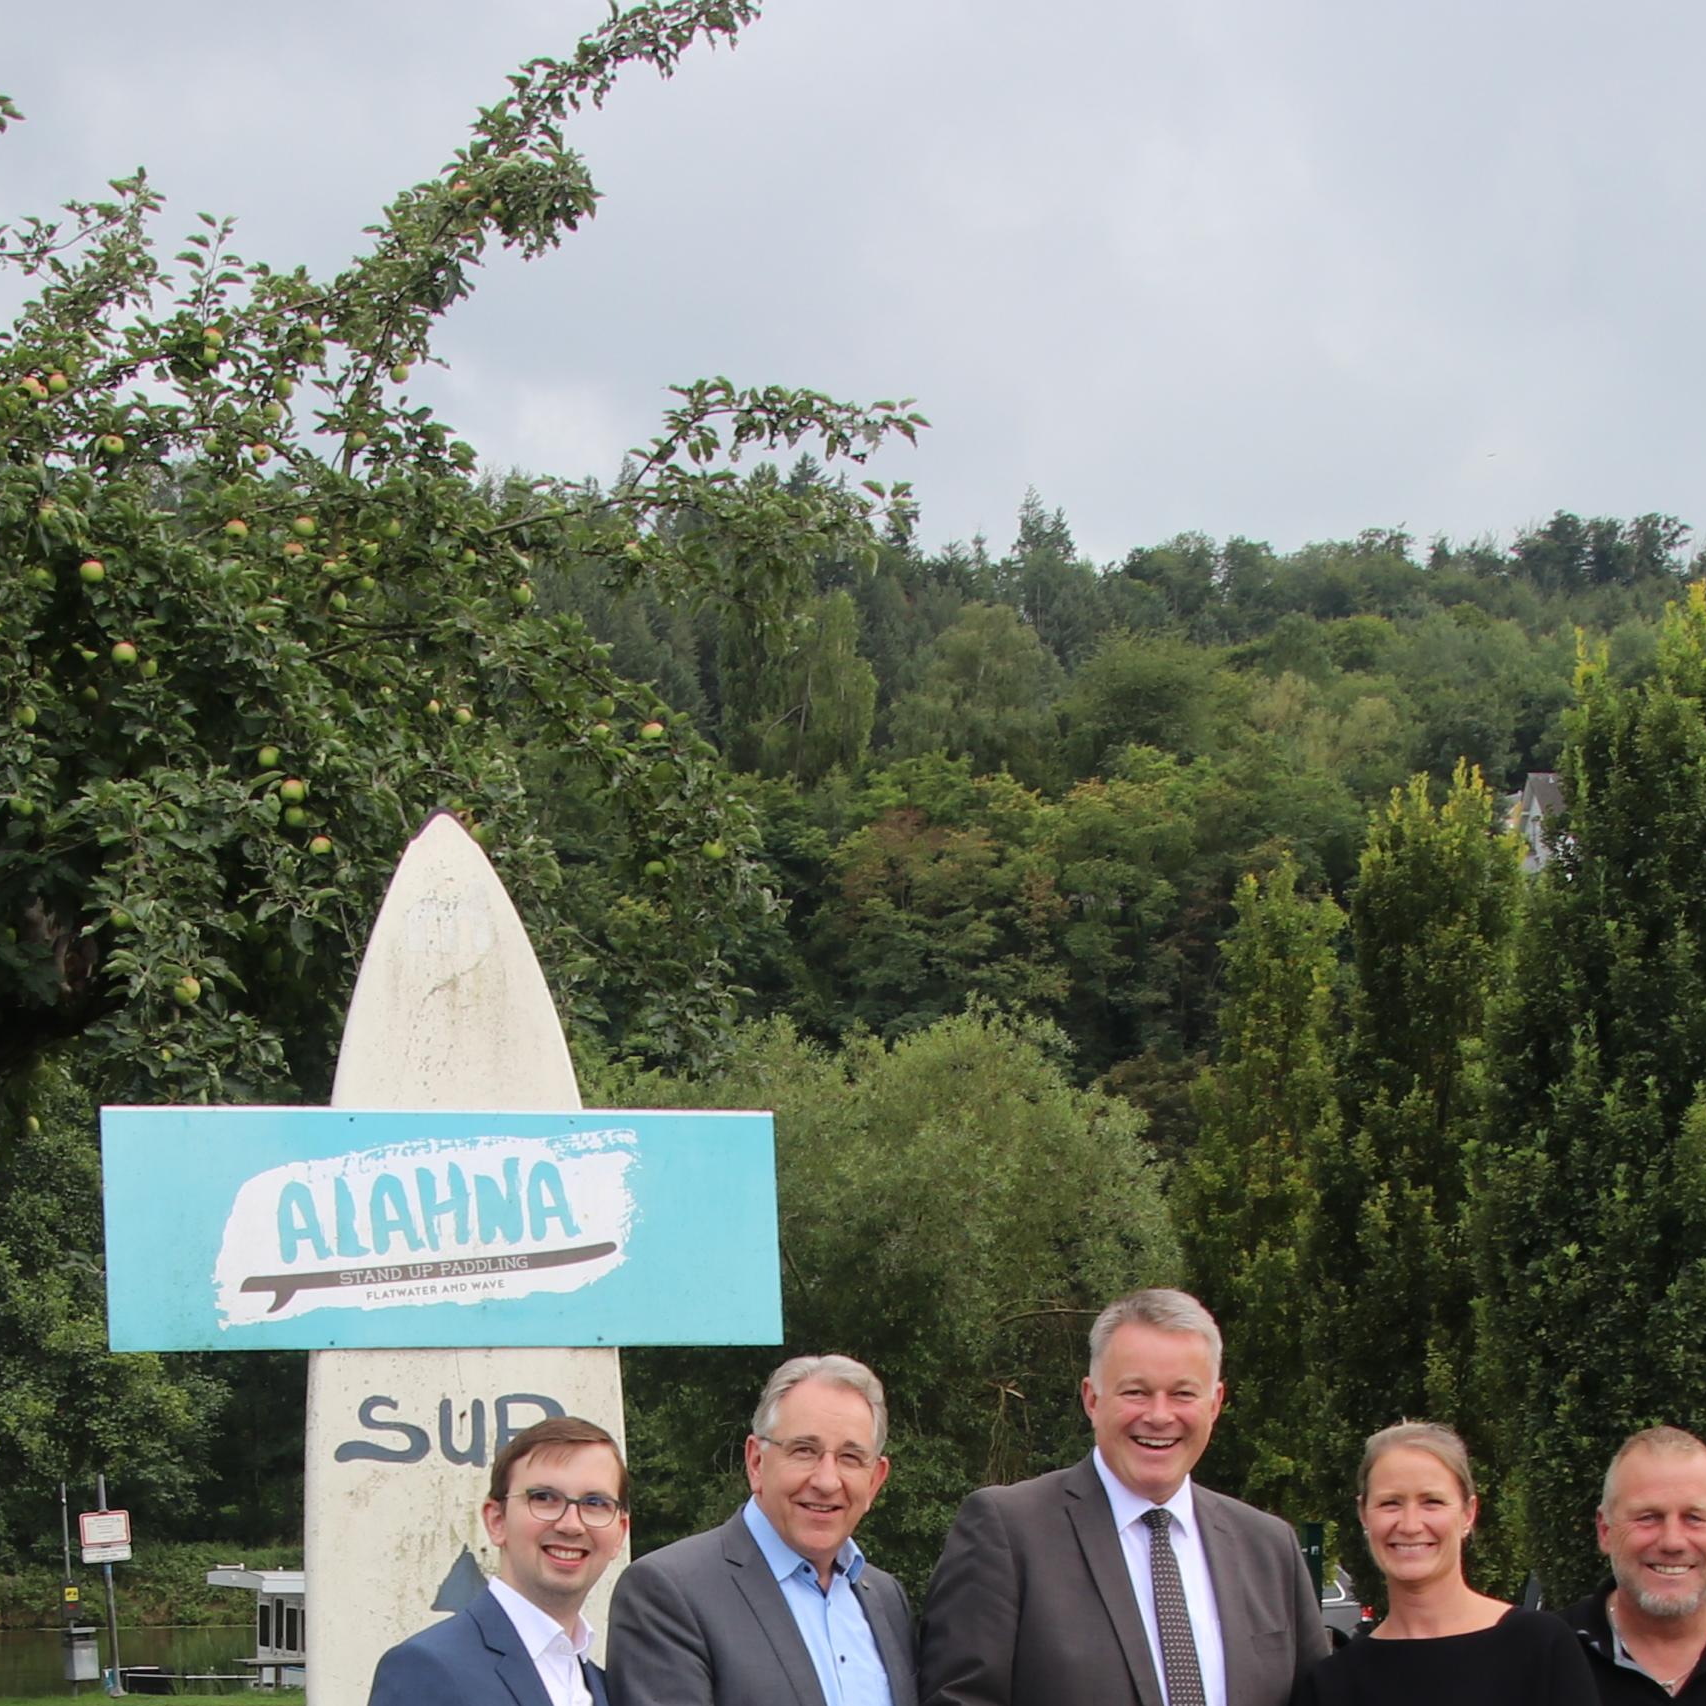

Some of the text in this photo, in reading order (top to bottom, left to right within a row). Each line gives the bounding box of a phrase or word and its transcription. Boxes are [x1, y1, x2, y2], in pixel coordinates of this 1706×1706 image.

[339, 1255, 530, 1286] STAND UP PADDLING
[366, 1279, 506, 1301] FLATWATER AND WAVE
[334, 1393, 568, 1468] SUP
